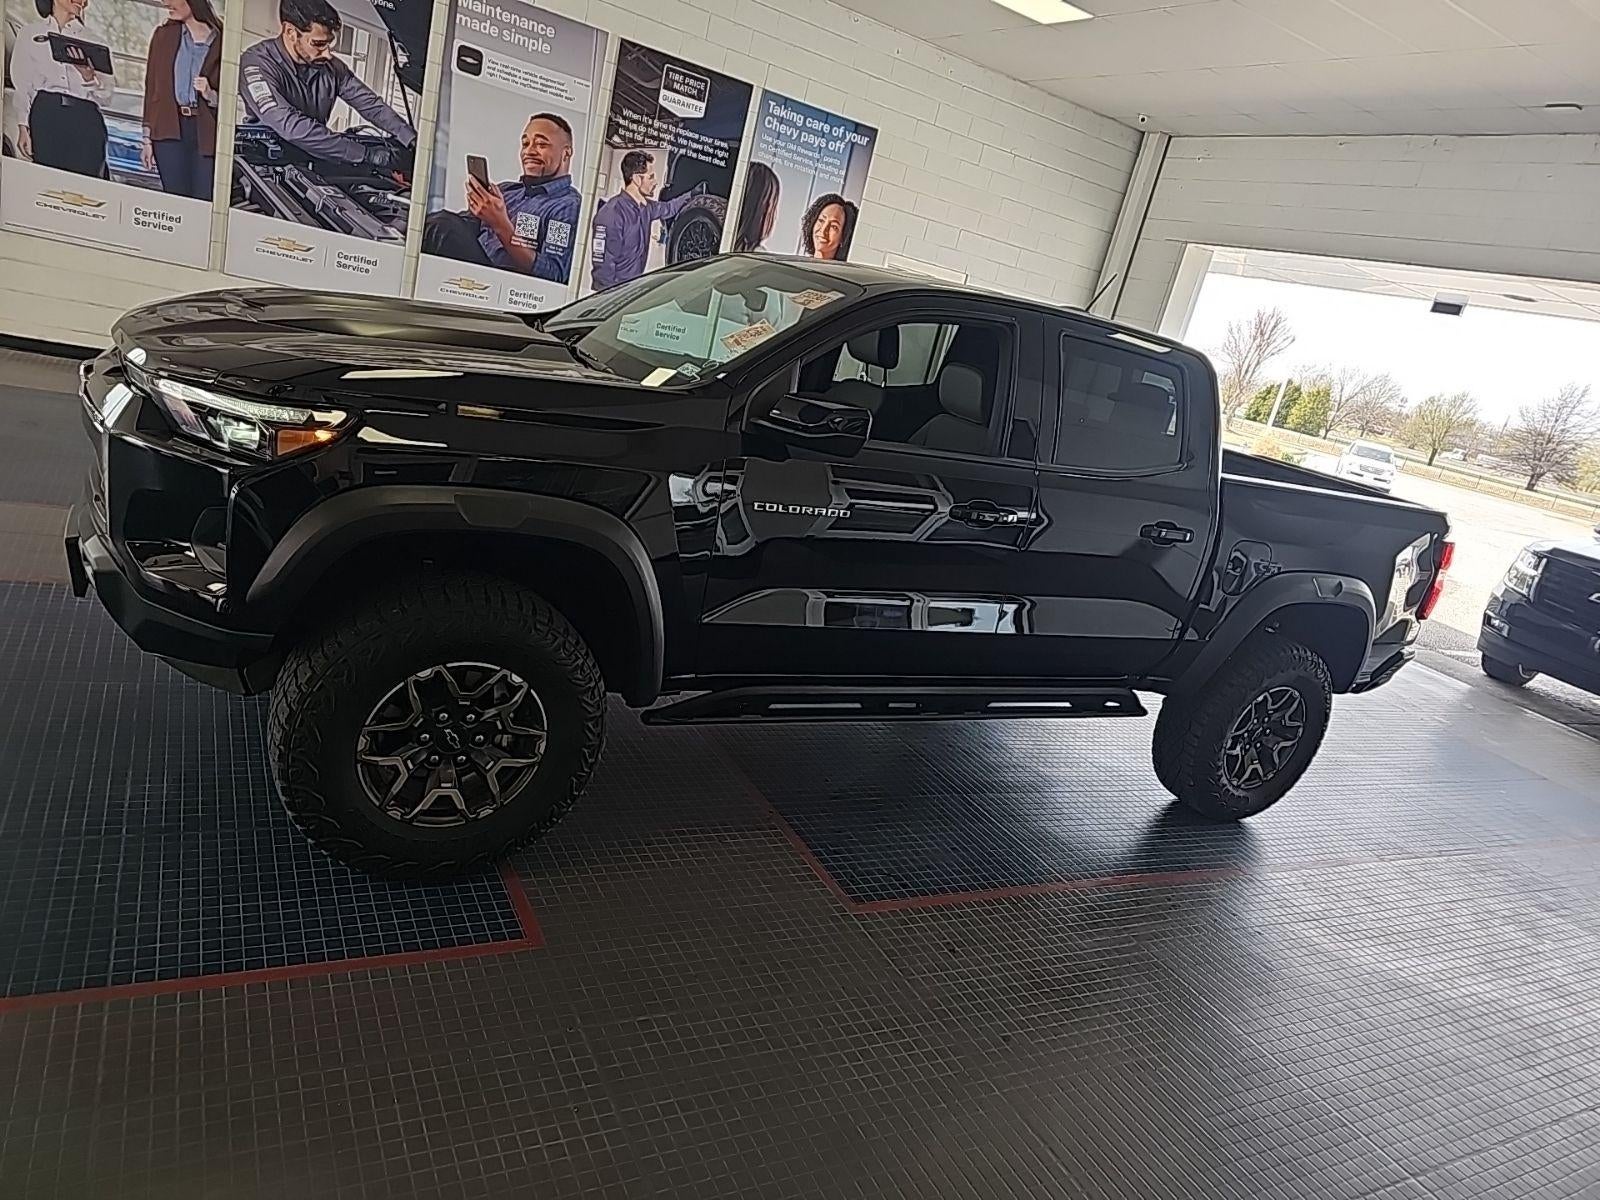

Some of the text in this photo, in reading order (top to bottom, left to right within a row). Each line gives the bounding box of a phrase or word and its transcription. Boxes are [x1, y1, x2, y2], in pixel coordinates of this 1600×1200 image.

[457, 0, 556, 38] Maintenance
[456, 12, 552, 54] made simple
[668, 71, 706, 91] TIRE PRICE
[672, 82, 698, 96] MATCH
[661, 94, 704, 114] GUARANTEE
[622, 108, 642, 121] When
[768, 100, 870, 147] Taking care of your
[761, 133, 773, 141] Use
[773, 139, 786, 148] your
[764, 116, 846, 154] Chevy pays off
[768, 144, 793, 159] Certified
[35, 201, 107, 220] CHEVROLET
[133, 207, 182, 224] Certified
[133, 217, 174, 232] Service
[255, 247, 315, 263] CHEVROLET
[336, 251, 378, 267] Certified
[335, 260, 371, 274] Service
[508, 297, 538, 310] Service
[509, 289, 544, 303] Certified
[655, 329, 680, 341] Service
[656, 322, 687, 334] Certified
[753, 501, 851, 518] COLORADO
